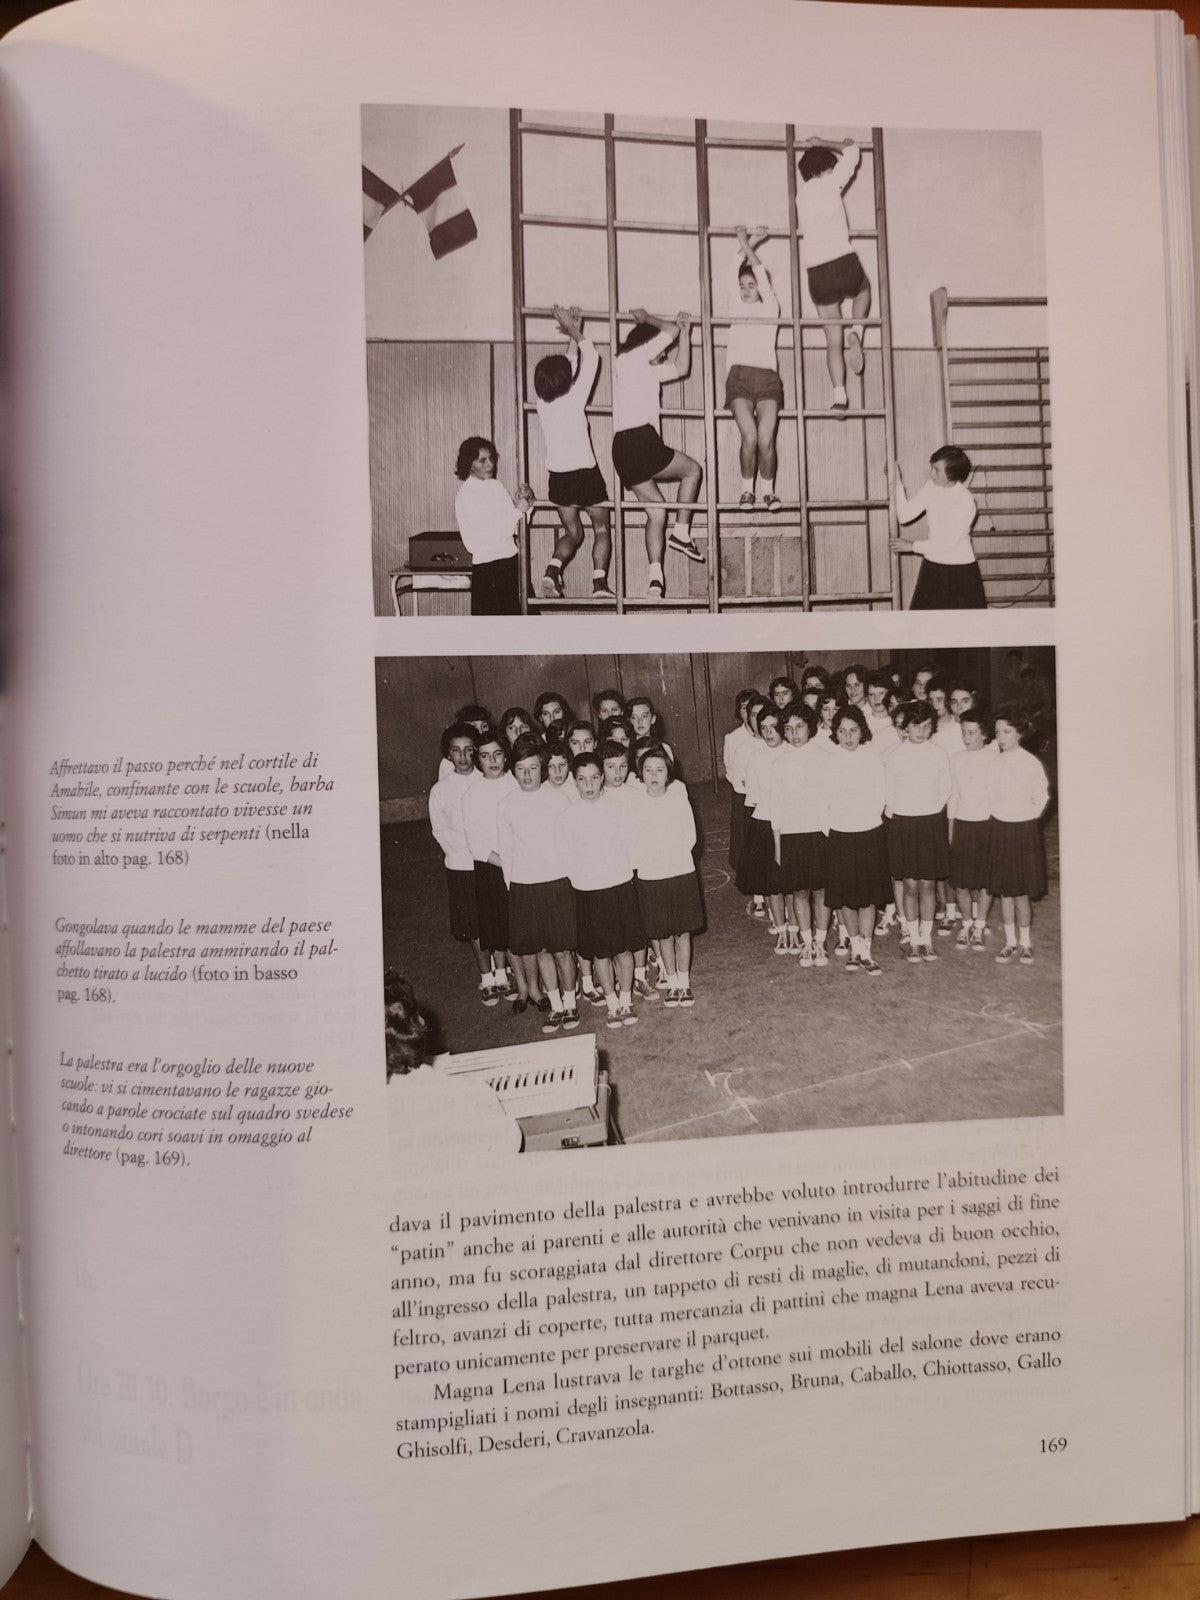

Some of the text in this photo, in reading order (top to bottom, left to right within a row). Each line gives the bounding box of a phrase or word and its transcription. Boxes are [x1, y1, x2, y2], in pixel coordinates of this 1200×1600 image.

[49, 753, 319, 778] Affrettavo il passo perché nel cortile di
[49, 776, 334, 799] Amabile, confinante con le scuole, barba
[53, 849, 189, 870] foto in alto pag. 168)
[55, 917, 331, 938] Gongolava quando le mamme del paese
[55, 940, 120, 958] affollavano
[124, 942, 137, 958] la
[140, 942, 196, 961] palestra
[200, 941, 289, 958] ammirando
[293, 940, 305, 956] il
[58, 987, 115, 1004] pag. 168).
[60, 1051, 73, 1067] La
[76, 1054, 123, 1072] palestra
[127, 1062, 148, 1073] era
[225, 1058, 262, 1074] delle
[267, 1062, 314, 1074] nuove
[61, 1076, 98, 1093] scuole:
[101, 1080, 114, 1094] vi
[117, 1081, 128, 1094] si
[131, 1082, 221, 1098] cimentavano
[226, 1081, 240, 1097] le
[244, 1085, 300, 1101] ragazze
[61, 1098, 353, 1125] cando a parole crociate sul quadro svedese
[389, 1166, 1059, 1233] dava il pavimento della palestra e avrebbe voluto introdurre l’abitudine dei
[391, 1193, 1059, 1266] “patin” anche ai parenti e alle autorità che venivano in visita per i saggi di fine
[391, 1220, 1061, 1291] anno, ma fu scoraggiata dal direttore Corpu che non vedeva di buon occhio,
[392, 1246, 1060, 1320] all’ingresso della palestra, un tappeto di resti di maglie, di mutandoni, pezzi di
[393, 1279, 1059, 1347] feltro, avanzi di coperte, tutta mercanzia di pattini che magna Lena aveva recu-
[394, 1328, 769, 1381] perato unicamente per preservare il parquet.
[434, 1330, 1061, 1402] Magna Lena lustrava le targhe d’ottone sui mobili del salone dove erano
[396, 1351, 1061, 1433] stampigliati i nomi degli insegnanti: Bottasso, Bruna, Caballo, Chiottasso, Gallo
[397, 1418, 654, 1460] Ghisolfi, Desderi, Cravanzola.
[1041, 1437, 1067, 1453] 169
